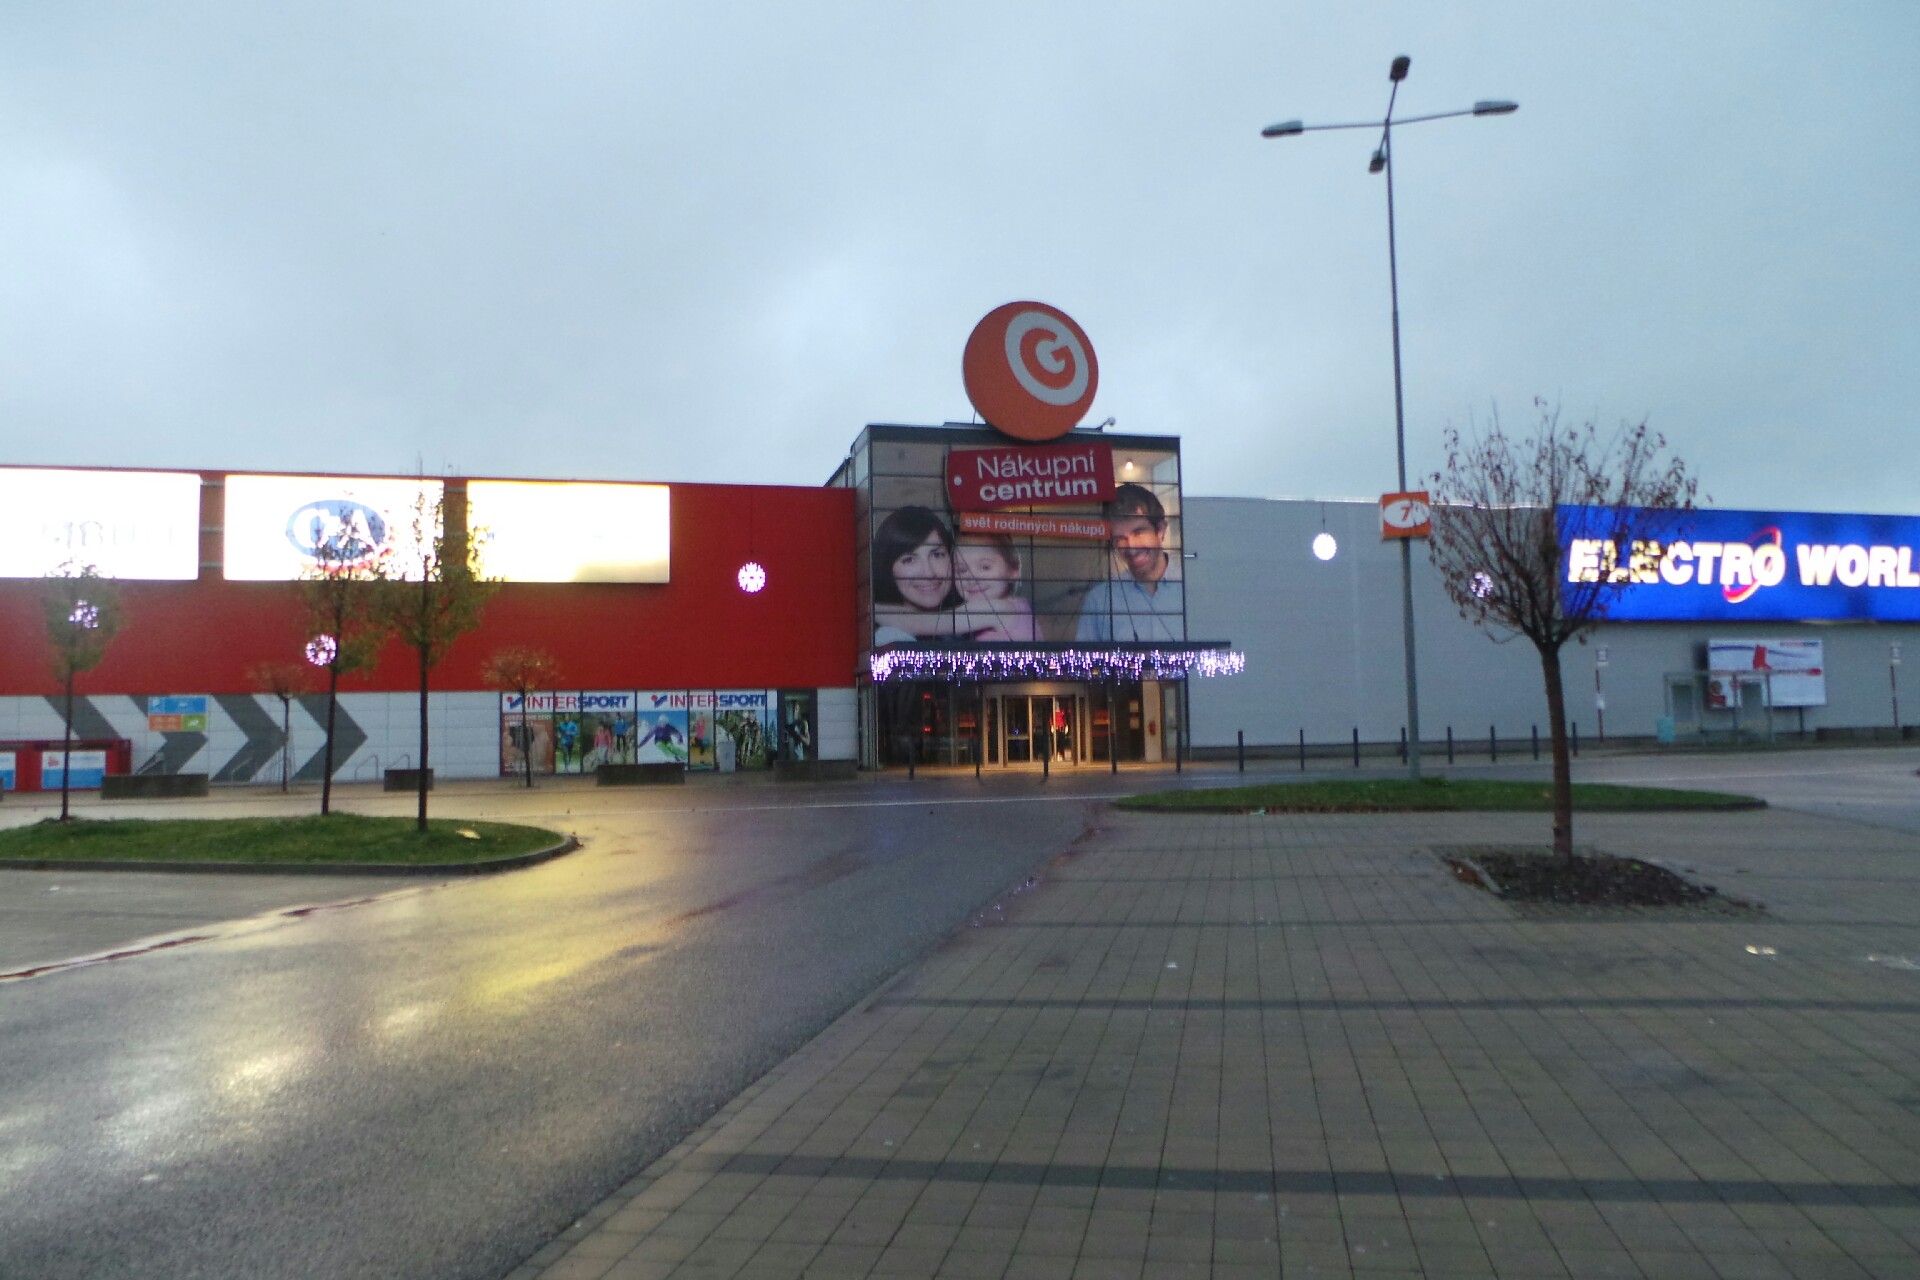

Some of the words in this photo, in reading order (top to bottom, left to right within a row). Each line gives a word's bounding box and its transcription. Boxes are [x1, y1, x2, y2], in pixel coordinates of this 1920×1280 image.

[1020, 328, 1076, 391] G
[976, 449, 1096, 479] Nákupní
[979, 477, 1098, 502] centrum
[964, 516, 991, 529] svět
[994, 516, 1057, 534] rodinných
[1059, 521, 1106, 536] nákupů
[1567, 538, 1787, 587] ELECTRO
[1796, 543, 1920, 588] WORL
[526, 695, 630, 709] INTERSPORT
[669, 694, 767, 708] INTERSPORT
